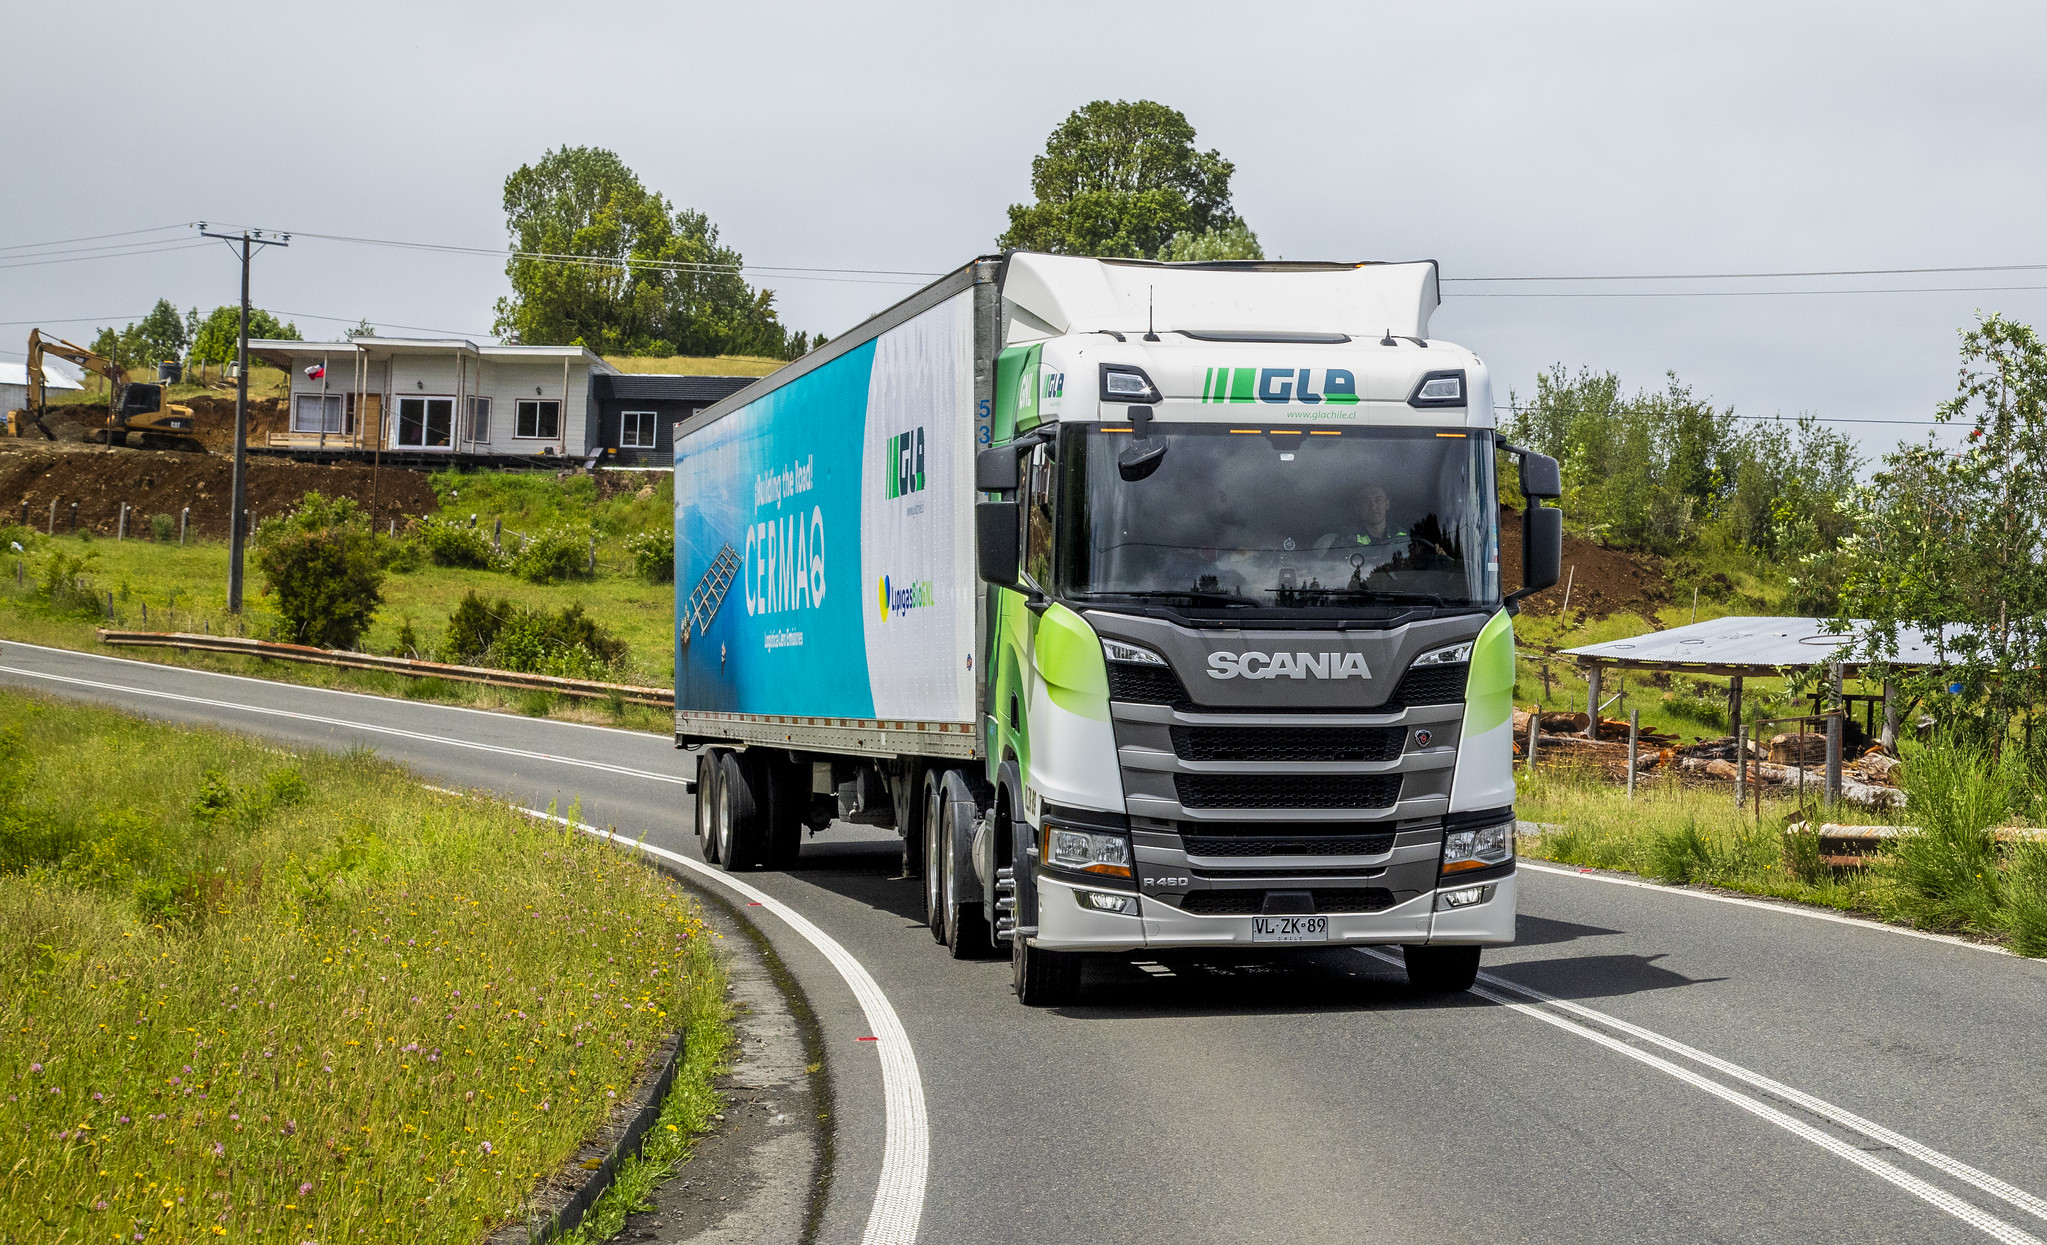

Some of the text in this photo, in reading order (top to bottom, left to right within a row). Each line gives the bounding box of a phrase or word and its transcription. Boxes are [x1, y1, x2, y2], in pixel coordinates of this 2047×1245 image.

[1259, 368, 1361, 405] GLA
[1287, 410, 1357, 420] www.glachile.cl
[782, 463, 795, 498] the
[745, 505, 826, 617] CERMAQ
[1206, 651, 1372, 680] SCANIA
[1156, 877, 1189, 886] 460
